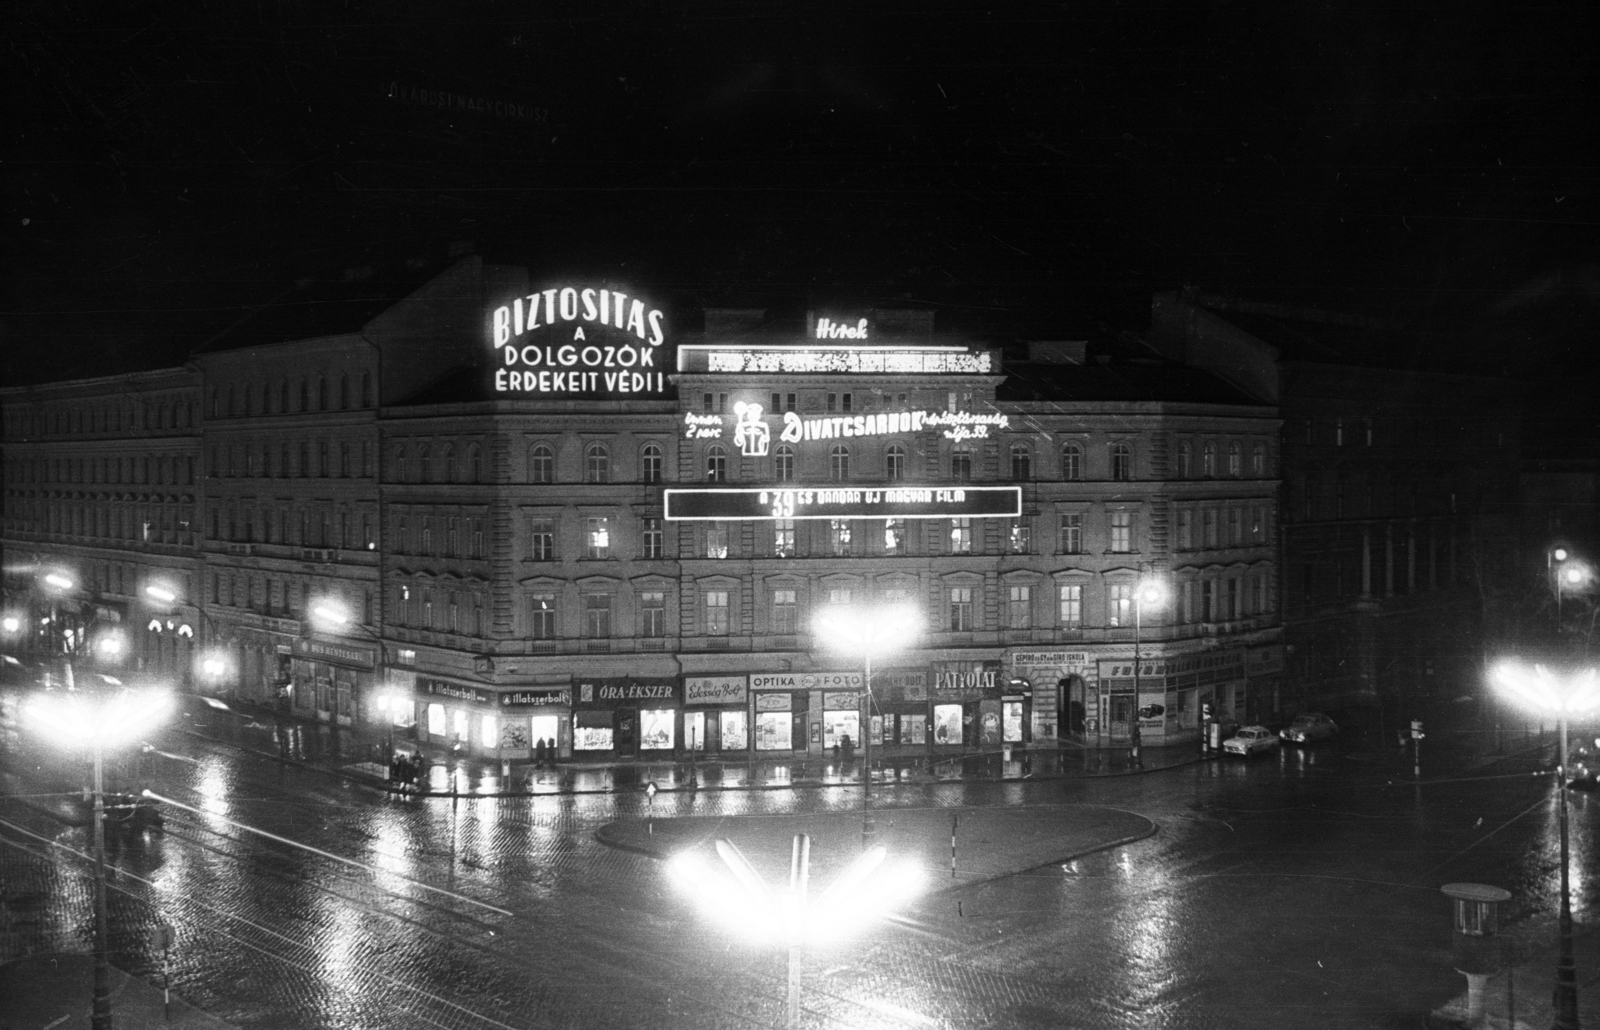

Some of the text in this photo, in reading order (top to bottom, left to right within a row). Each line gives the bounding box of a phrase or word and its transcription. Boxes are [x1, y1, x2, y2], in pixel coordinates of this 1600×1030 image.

[574, 326, 586, 341] A
[505, 344, 654, 367] DOLGOZÓK
[495, 368, 599, 392] ÉRDEKEIT
[684, 411, 723, 425] innen
[686, 423, 697, 438] 2
[779, 411, 923, 443] DIVATCSARNOK
[759, 491, 768, 505] A
[771, 491, 794, 518] 39
[885, 490, 931, 504] MAGYAR
[936, 490, 965, 503] FILM
[753, 677, 796, 688] OPTIKA
[823, 675, 860, 685] FOTO
[934, 671, 997, 689] PATYOLAT
[512, 692, 566, 704] illatszerbolt
